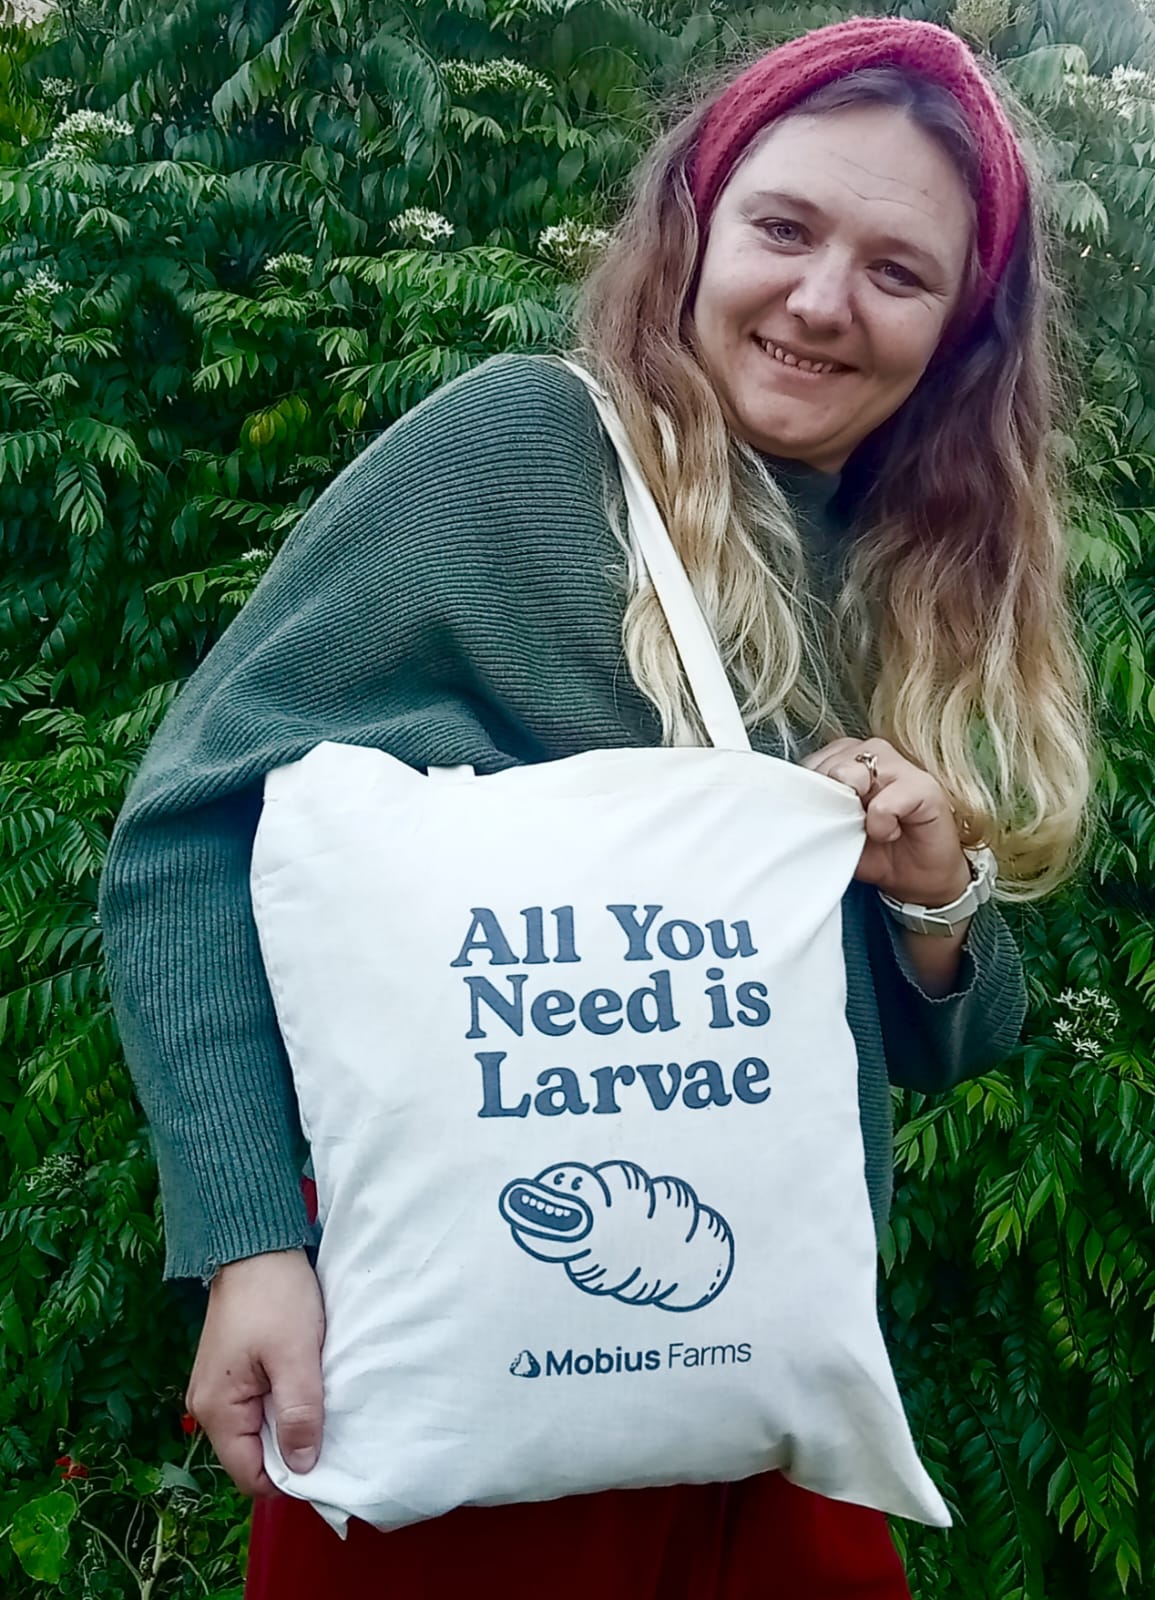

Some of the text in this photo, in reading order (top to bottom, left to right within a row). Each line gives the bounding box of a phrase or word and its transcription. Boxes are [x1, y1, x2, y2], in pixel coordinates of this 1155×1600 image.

[450, 904, 759, 967] All You
[463, 967, 772, 1039] Need is
[474, 1051, 772, 1118] Larvae
[545, 1342, 752, 1377] Mobius Farms
